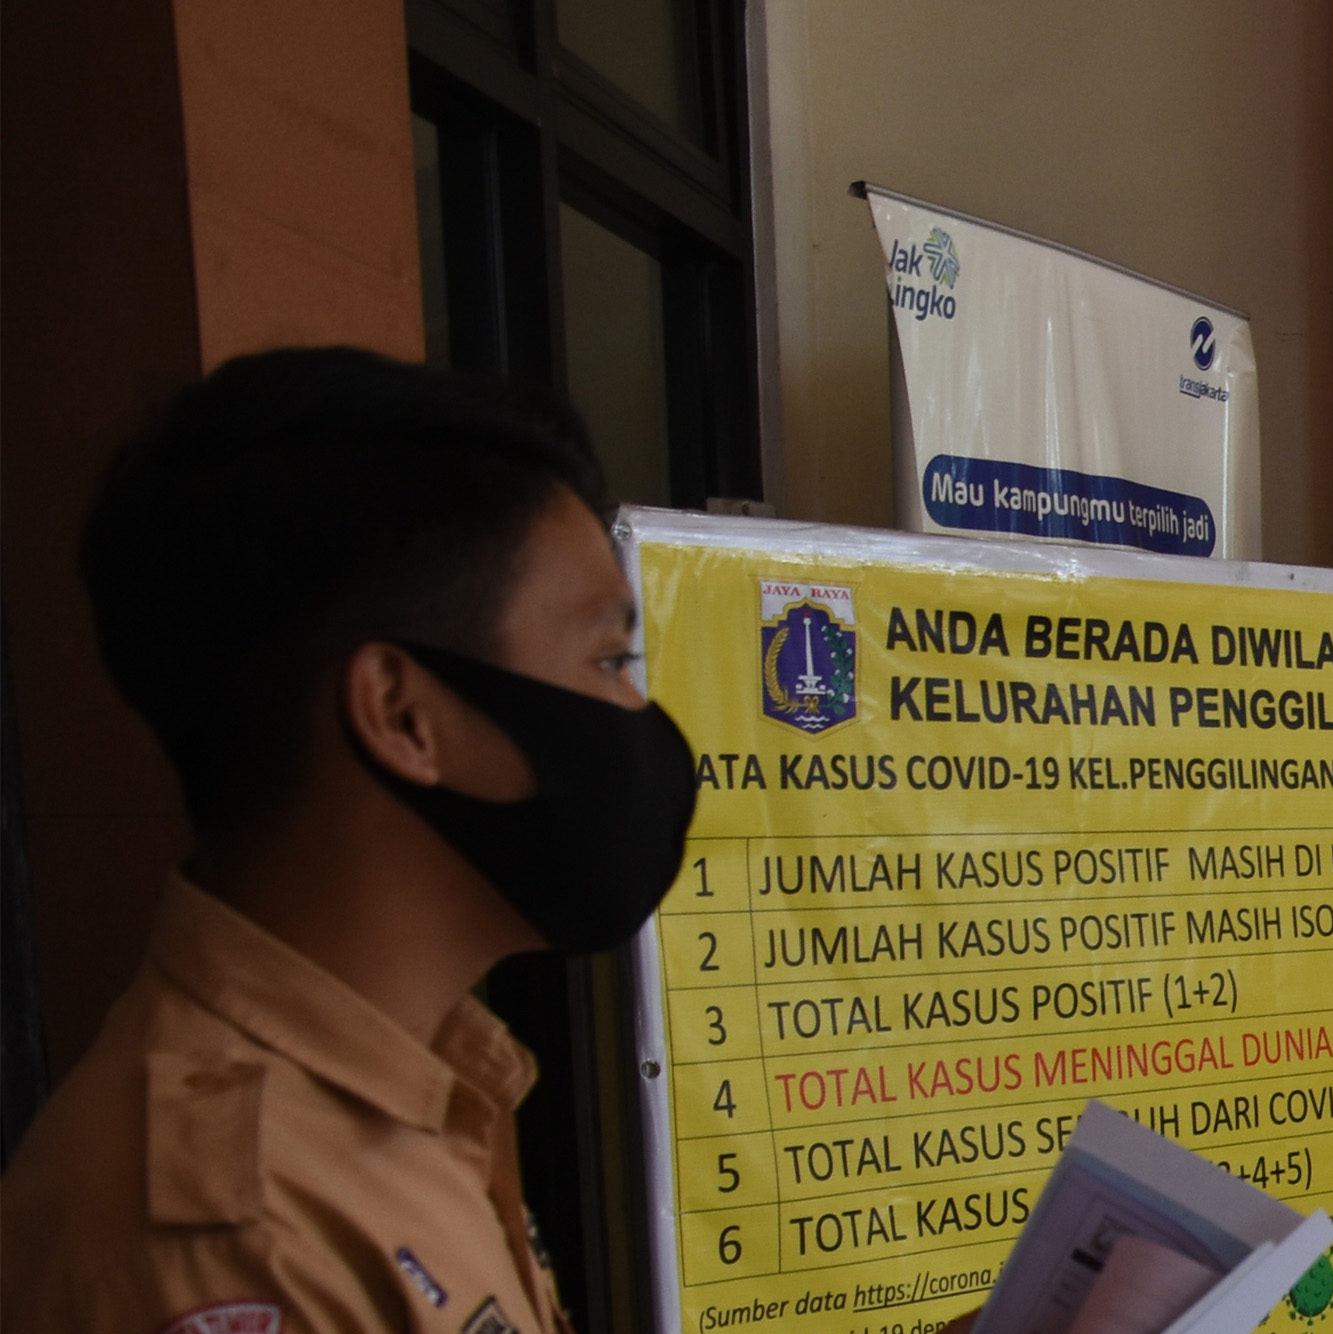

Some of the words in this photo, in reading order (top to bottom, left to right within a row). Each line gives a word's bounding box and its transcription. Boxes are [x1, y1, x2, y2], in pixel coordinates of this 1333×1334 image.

[891, 275, 956, 321] ingko
[931, 472, 984, 507] Mau
[994, 478, 1125, 526] kampungmu
[1129, 499, 1180, 537] terpilih
[1182, 509, 1210, 543] jadi
[762, 585, 801, 597] JAYA
[811, 588, 850, 600] RAYA
[886, 607, 1010, 657] ANDA
[1025, 615, 1199, 666] BERADA
[891, 676, 1155, 727] KELURAHAN
[696, 753, 767, 790] ATA
[779, 753, 898, 791] KASUS
[907, 755, 1060, 791] COVID-19
[693, 858, 714, 897] 1
[759, 853, 921, 895] JUMLAH
[936, 850, 1043, 889] KASUS
[1055, 847, 1170, 885] POSITIF
[1189, 845, 1284, 881] MASIH
[1295, 844, 1321, 877] DI
[698, 931, 720, 972] 2
[764, 923, 923, 968] JUMLAH
[939, 917, 1051, 959] KASUS
[1061, 911, 1176, 951] POSITIF
[1187, 906, 1282, 945] MASIH
[705, 1006, 727, 1046] 3
[768, 996, 891, 1040] TOTAL
[904, 987, 1020, 1030] KASUS
[1033, 978, 1150, 1020] POSITIF
[1164, 969, 1238, 1018] (1+2)
[713, 1080, 737, 1118] 4
[775, 1066, 897, 1112] TOTAL
[908, 1054, 1022, 1099] KASUS
[1034, 1035, 1234, 1089] MENINGGAL
[1242, 1026, 1333, 1066] DUNIA
[717, 1153, 741, 1193] 5
[784, 1135, 902, 1184] TOTAL
[914, 1120, 1026, 1168] KASUS
[1036, 1104, 1179, 1153] SEUH
[1191, 1095, 1259, 1136] DARI
[718, 1225, 742, 1264] 6
[790, 1206, 906, 1255] TOTAL
[916, 1188, 1029, 1237] KASUS
[699, 1298, 789, 1334] (Sumber
[795, 1291, 847, 1315] data
